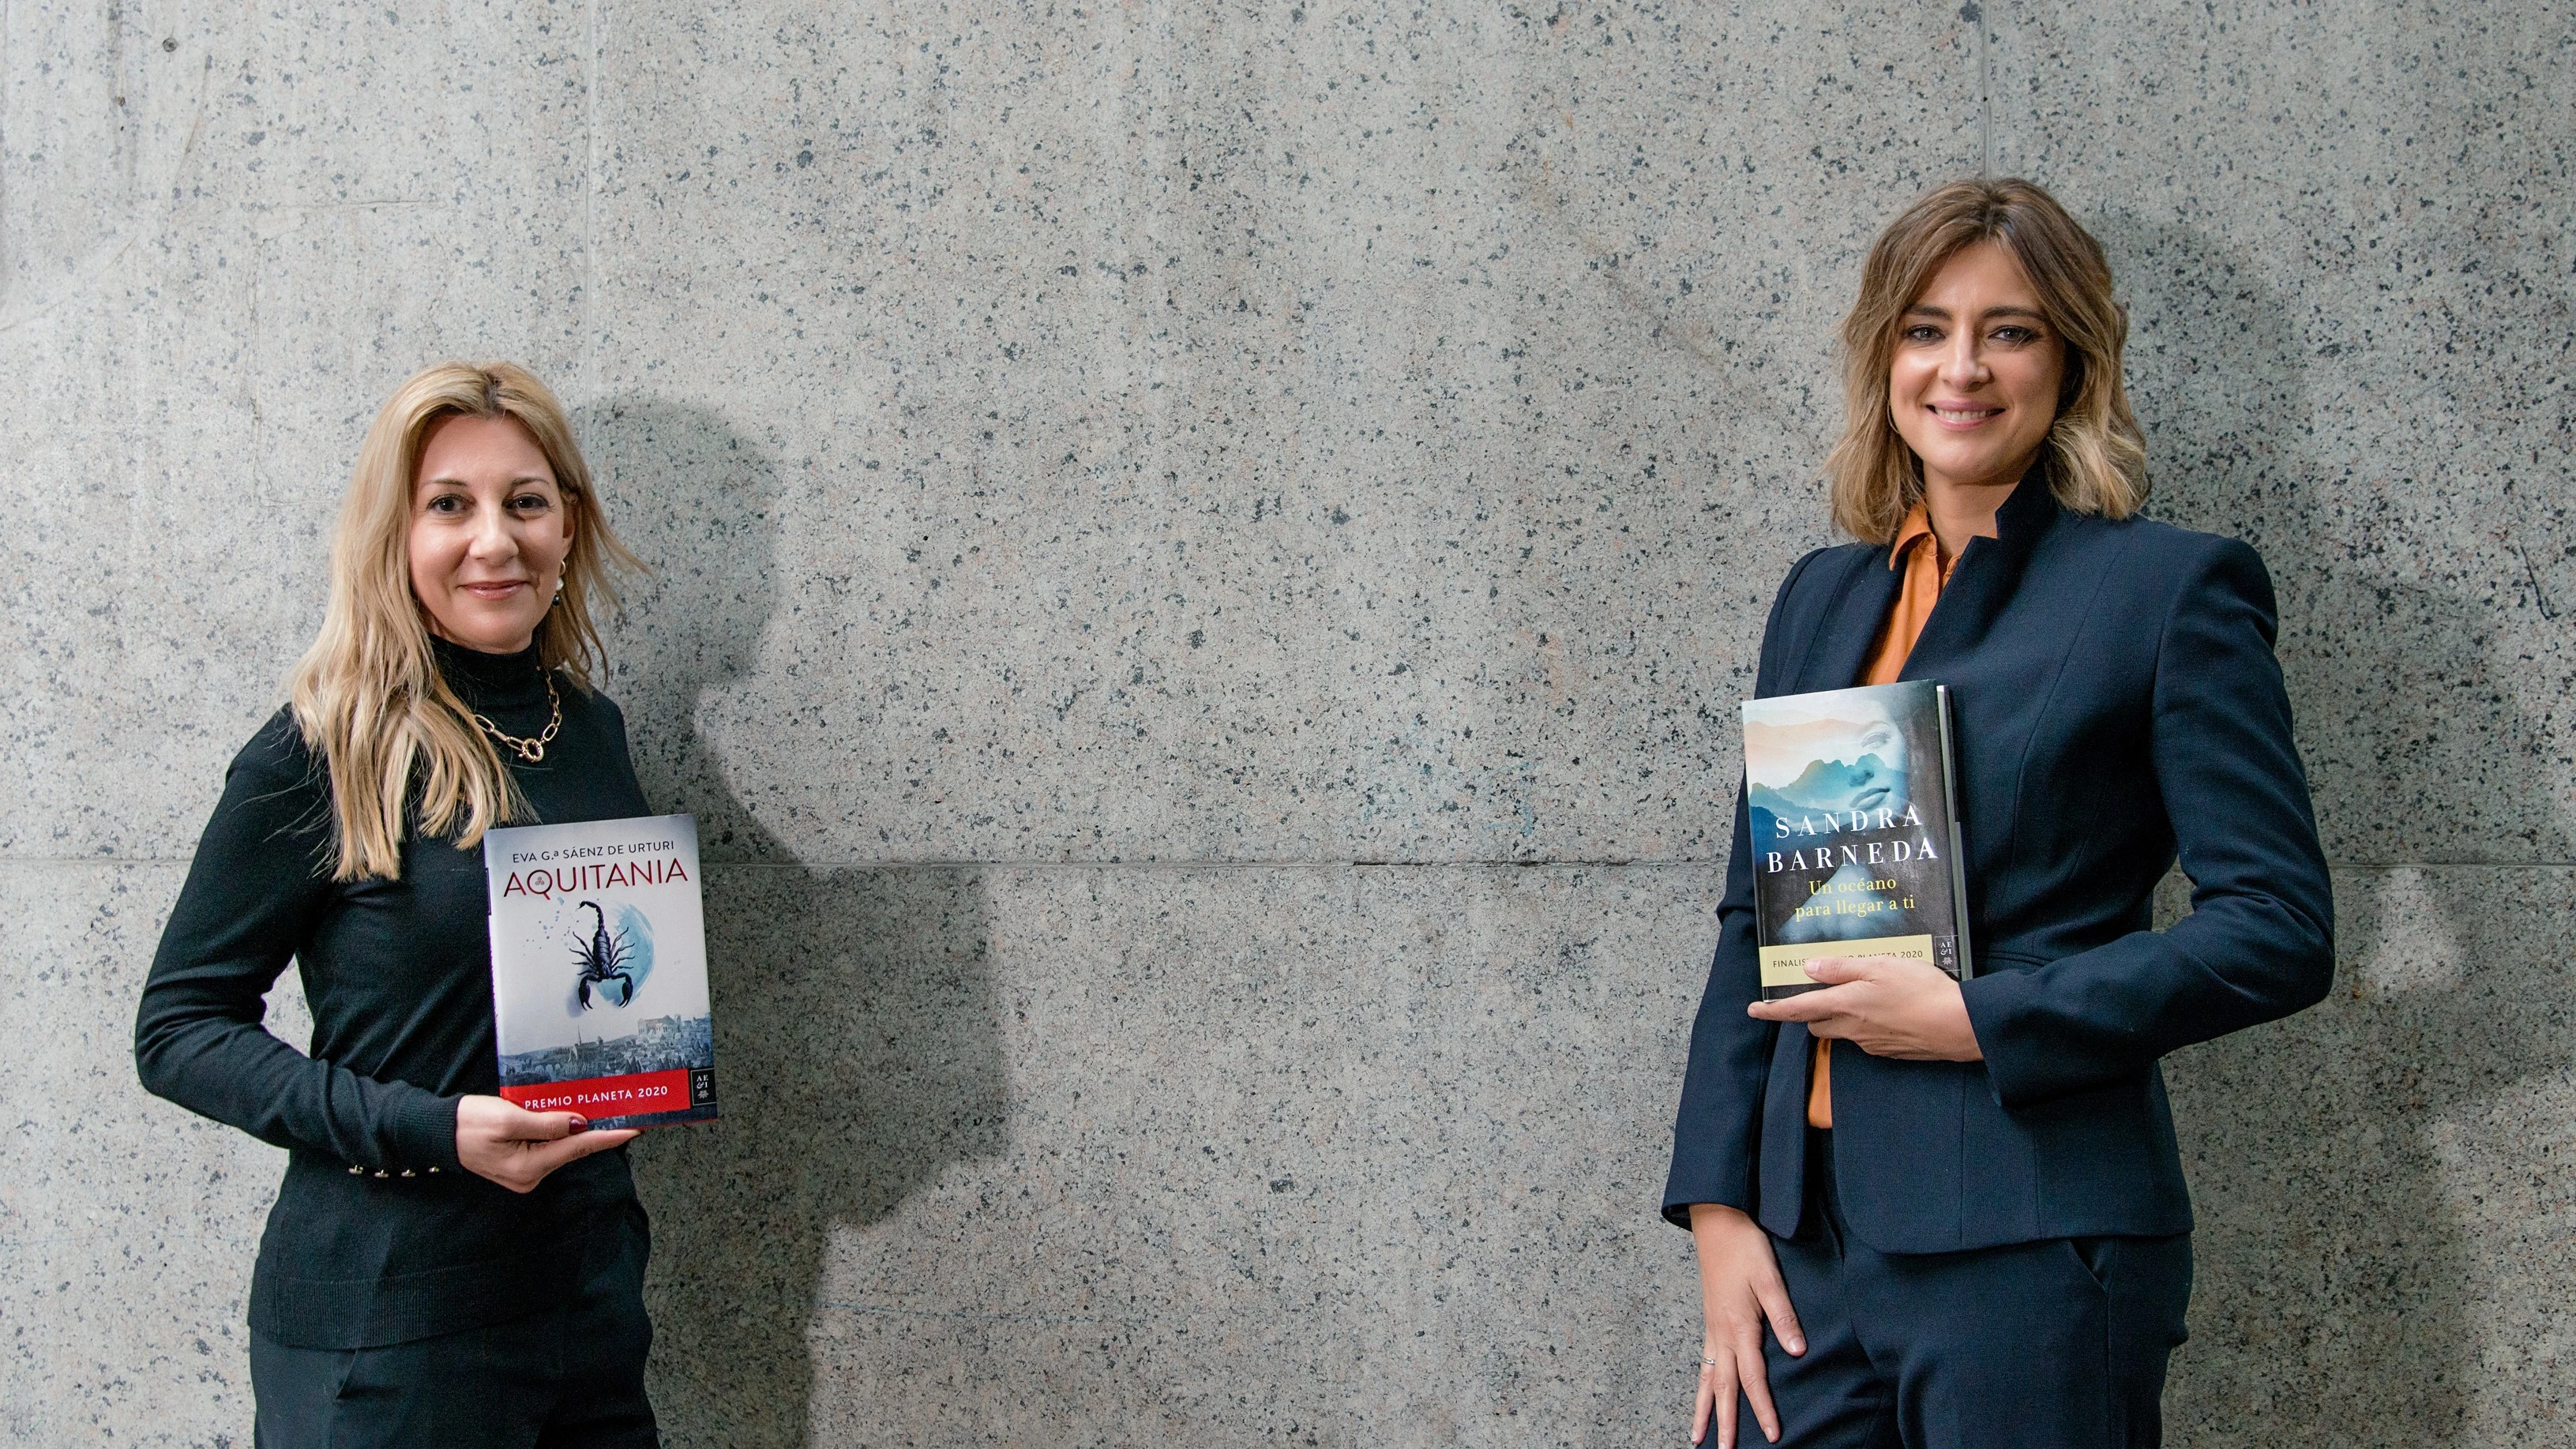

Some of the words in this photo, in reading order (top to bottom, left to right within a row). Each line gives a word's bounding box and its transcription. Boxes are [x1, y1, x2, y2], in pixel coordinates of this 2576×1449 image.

[1775, 805, 1922, 839] SANDRA
[513, 853, 537, 863] EVA
[563, 846, 603, 859] SÁENZ
[608, 844, 624, 855] DE
[628, 840, 674, 854] URTURI
[1767, 837, 1938, 873] BARNEDA
[503, 858, 688, 900] AQUITANIA
[1809, 880, 1832, 895] Un
[1838, 877, 1896, 893] océano
[1795, 906, 1831, 922] para
[1836, 899, 1884, 918] llegar
[1889, 899, 1898, 910] a
[1902, 894, 1915, 908] ti
[1773, 958, 1809, 967] FINALIS
[1901, 950, 1923, 959] 2020
[524, 1096, 573, 1110] PREMIO
[577, 1090, 633, 1103] PLANETA
[638, 1086, 668, 1098] 2020
